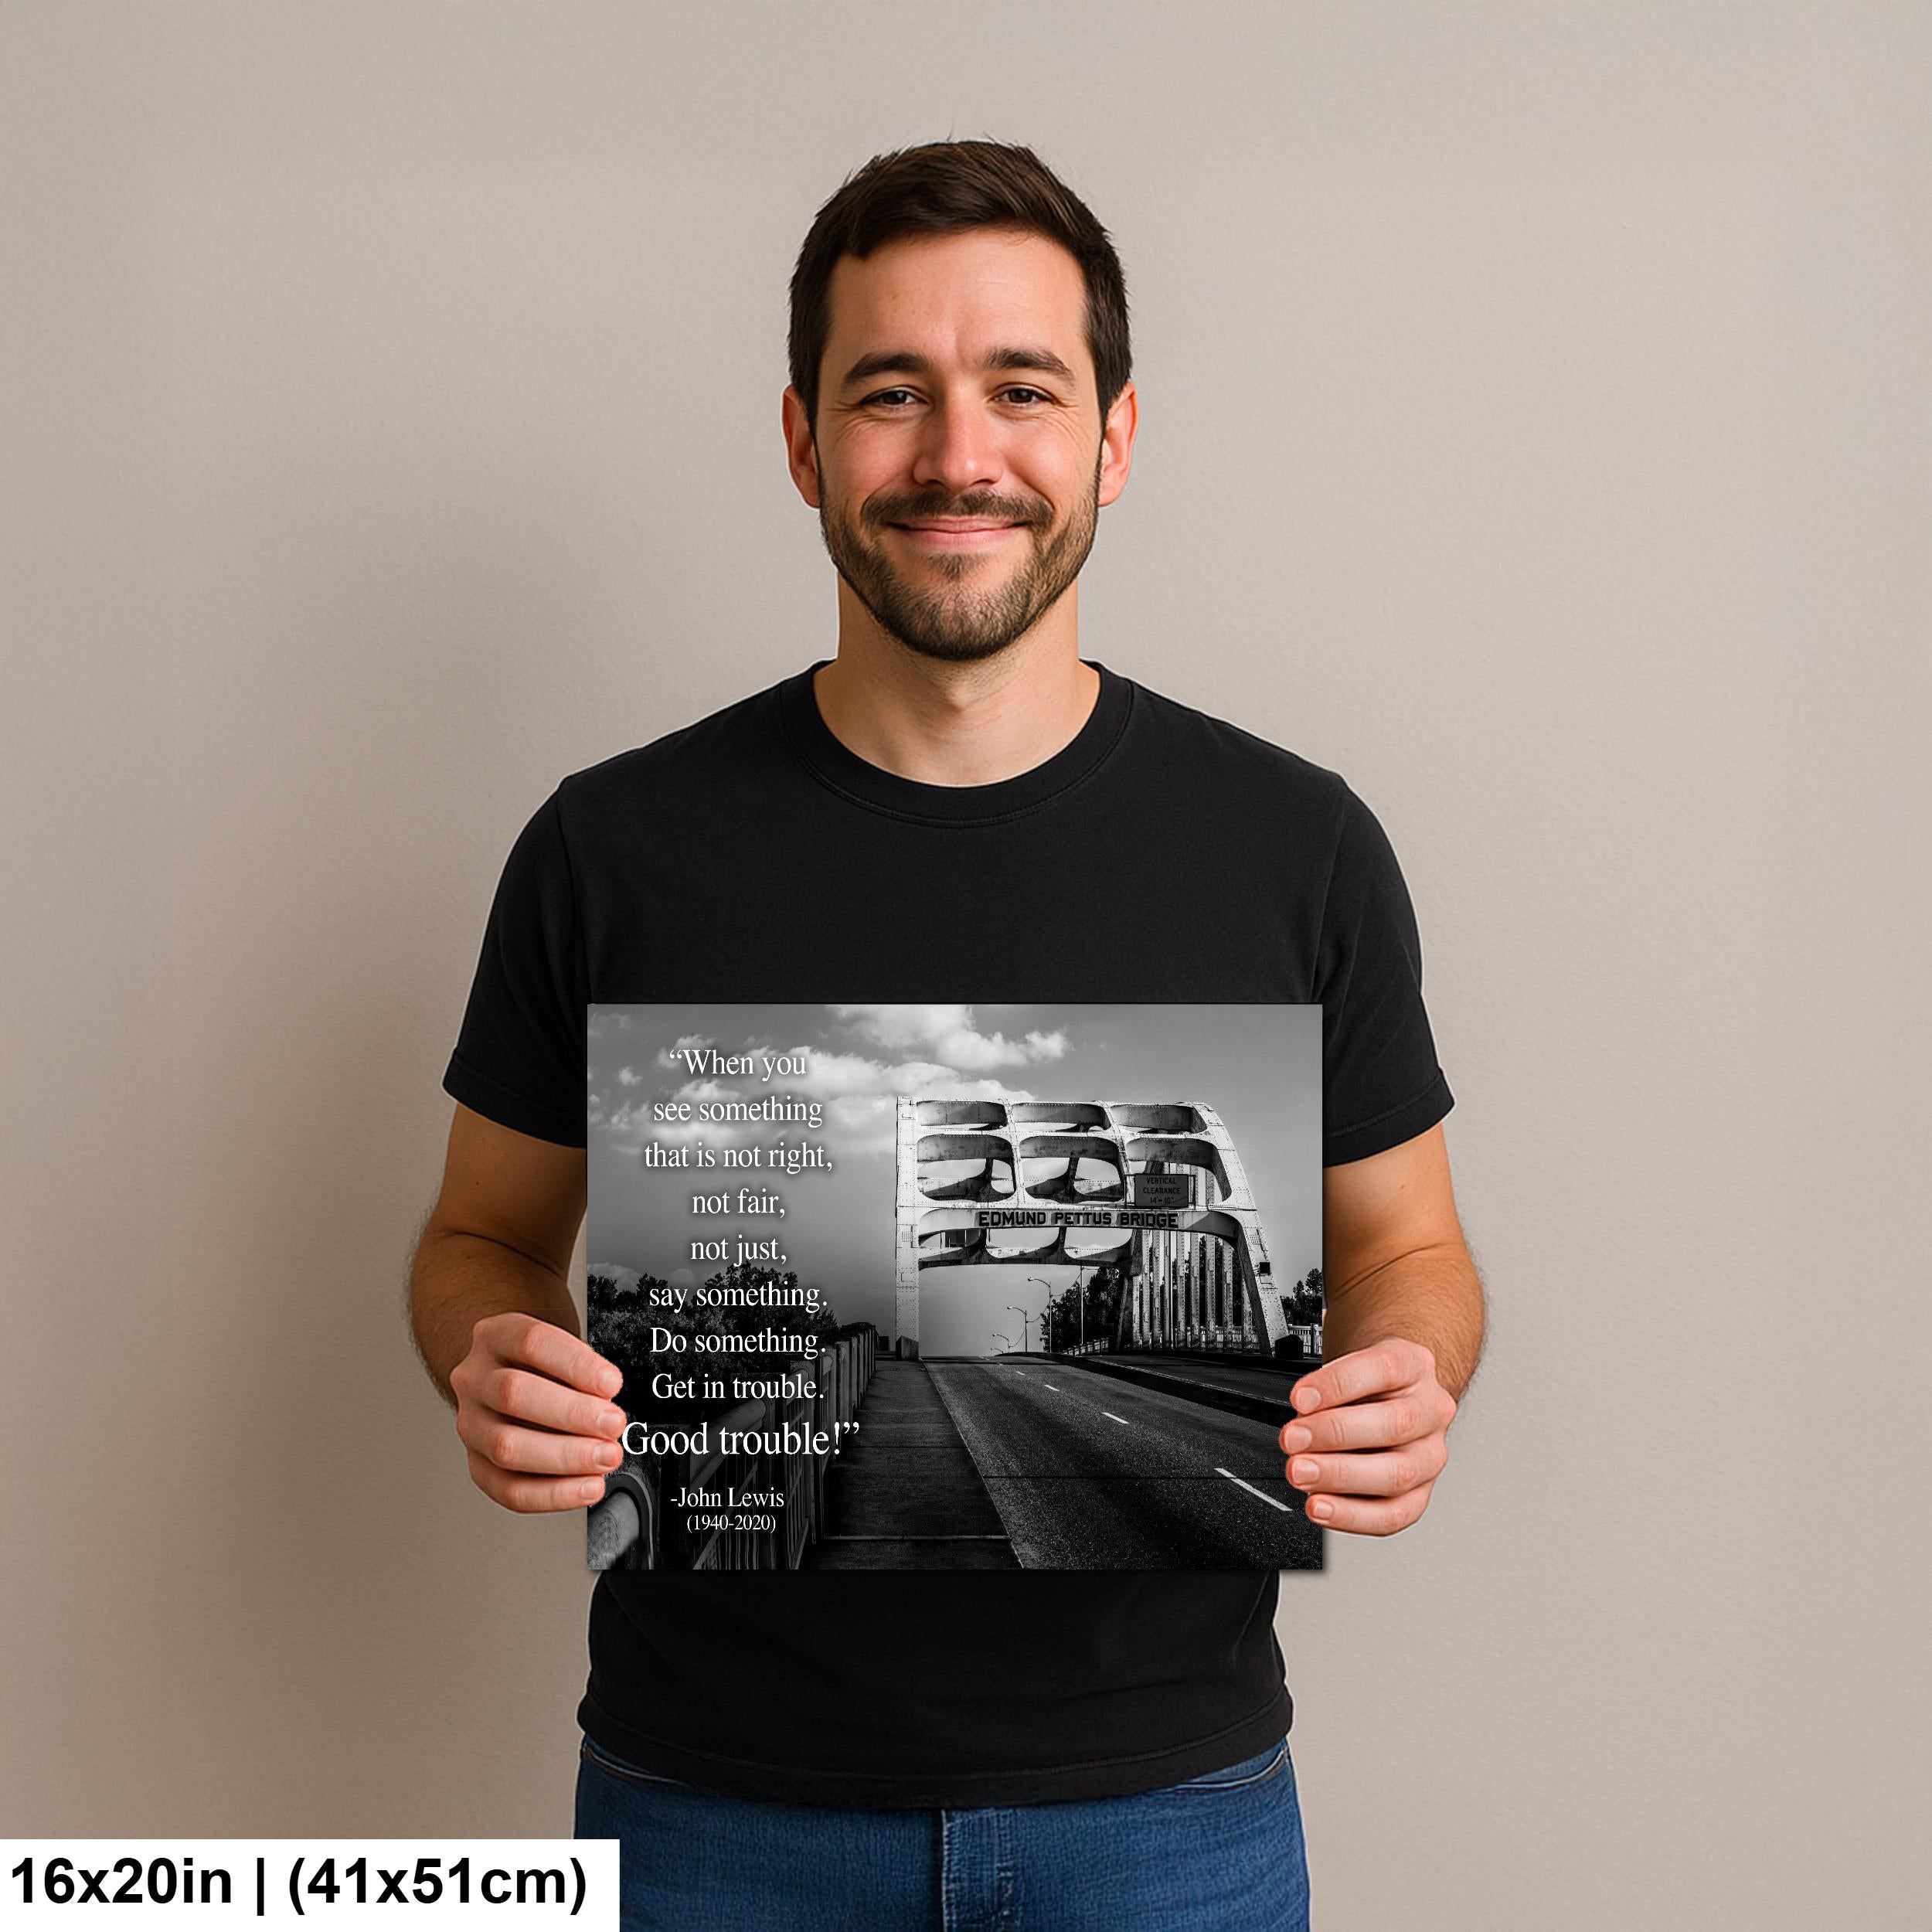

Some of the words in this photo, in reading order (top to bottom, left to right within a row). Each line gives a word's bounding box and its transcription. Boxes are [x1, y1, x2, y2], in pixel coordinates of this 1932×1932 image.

[669, 1049, 753, 1075] “When
[762, 1057, 807, 1081] you
[654, 1102, 691, 1121] see
[699, 1096, 822, 1128] something
[645, 1142, 689, 1167] that
[697, 1142, 716, 1167] is
[723, 1145, 761, 1168] not
[768, 1142, 832, 1174] right,
[692, 1192, 730, 1214] not
[737, 1189, 785, 1218] fair,
[978, 1212, 1046, 1226] EDMUND
[1054, 1212, 1112, 1226] PETTUS
[1122, 1213, 1179, 1229] BRIDGE
[691, 1238, 729, 1260] not
[733, 1235, 787, 1267] just,
[649, 1288, 688, 1313] say
[696, 1281, 828, 1313] something.
[650, 1328, 687, 1353] Do
[695, 1327, 826, 1359] something.
[652, 1373, 696, 1399] Get
[702, 1374, 726, 1399] in
[733, 1374, 824, 1399] trouble.
[621, 1421, 709, 1454] Good
[719, 1421, 859, 1455] trouble!”
[671, 1487, 722, 1508] -John
[727, 1487, 784, 1507] Lewis
[687, 1515, 776, 1533] (1940-2020)
